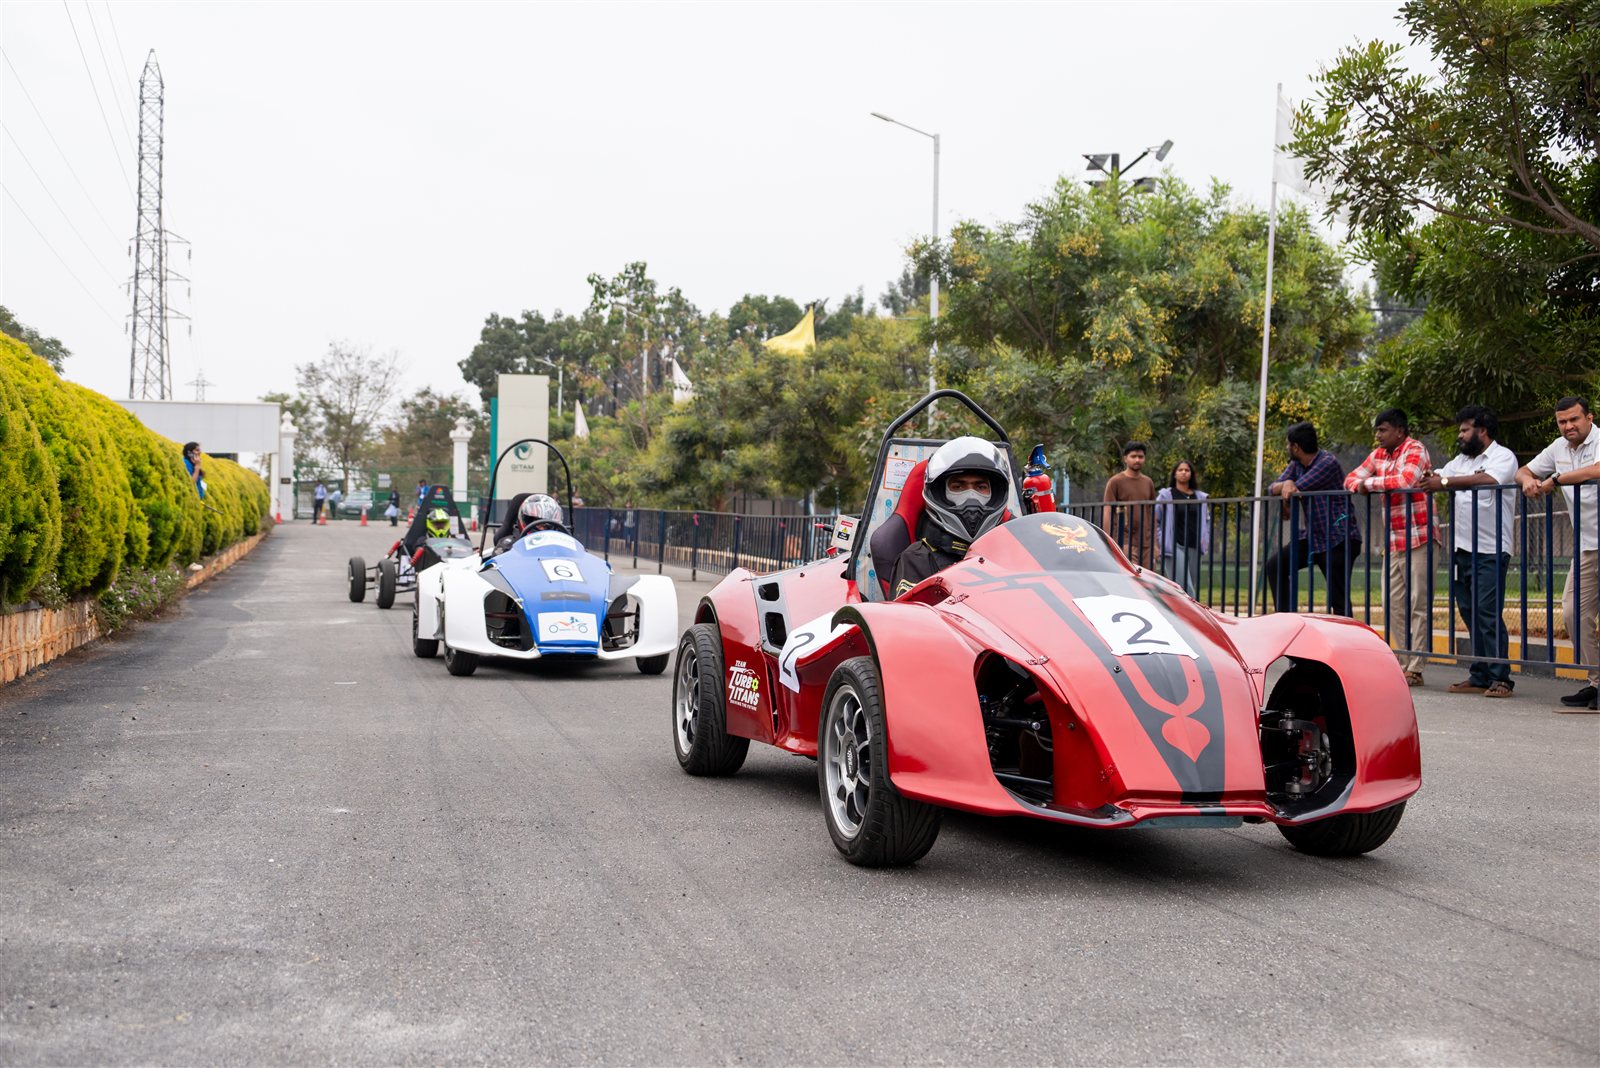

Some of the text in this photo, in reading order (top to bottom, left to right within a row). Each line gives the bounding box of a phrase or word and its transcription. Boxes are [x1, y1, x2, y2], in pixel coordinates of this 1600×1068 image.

[553, 565, 573, 578] 6
[1111, 611, 1171, 646] 2
[782, 632, 815, 678] 2
[729, 666, 759, 691] TURBO
[729, 686, 760, 706] TITANS
